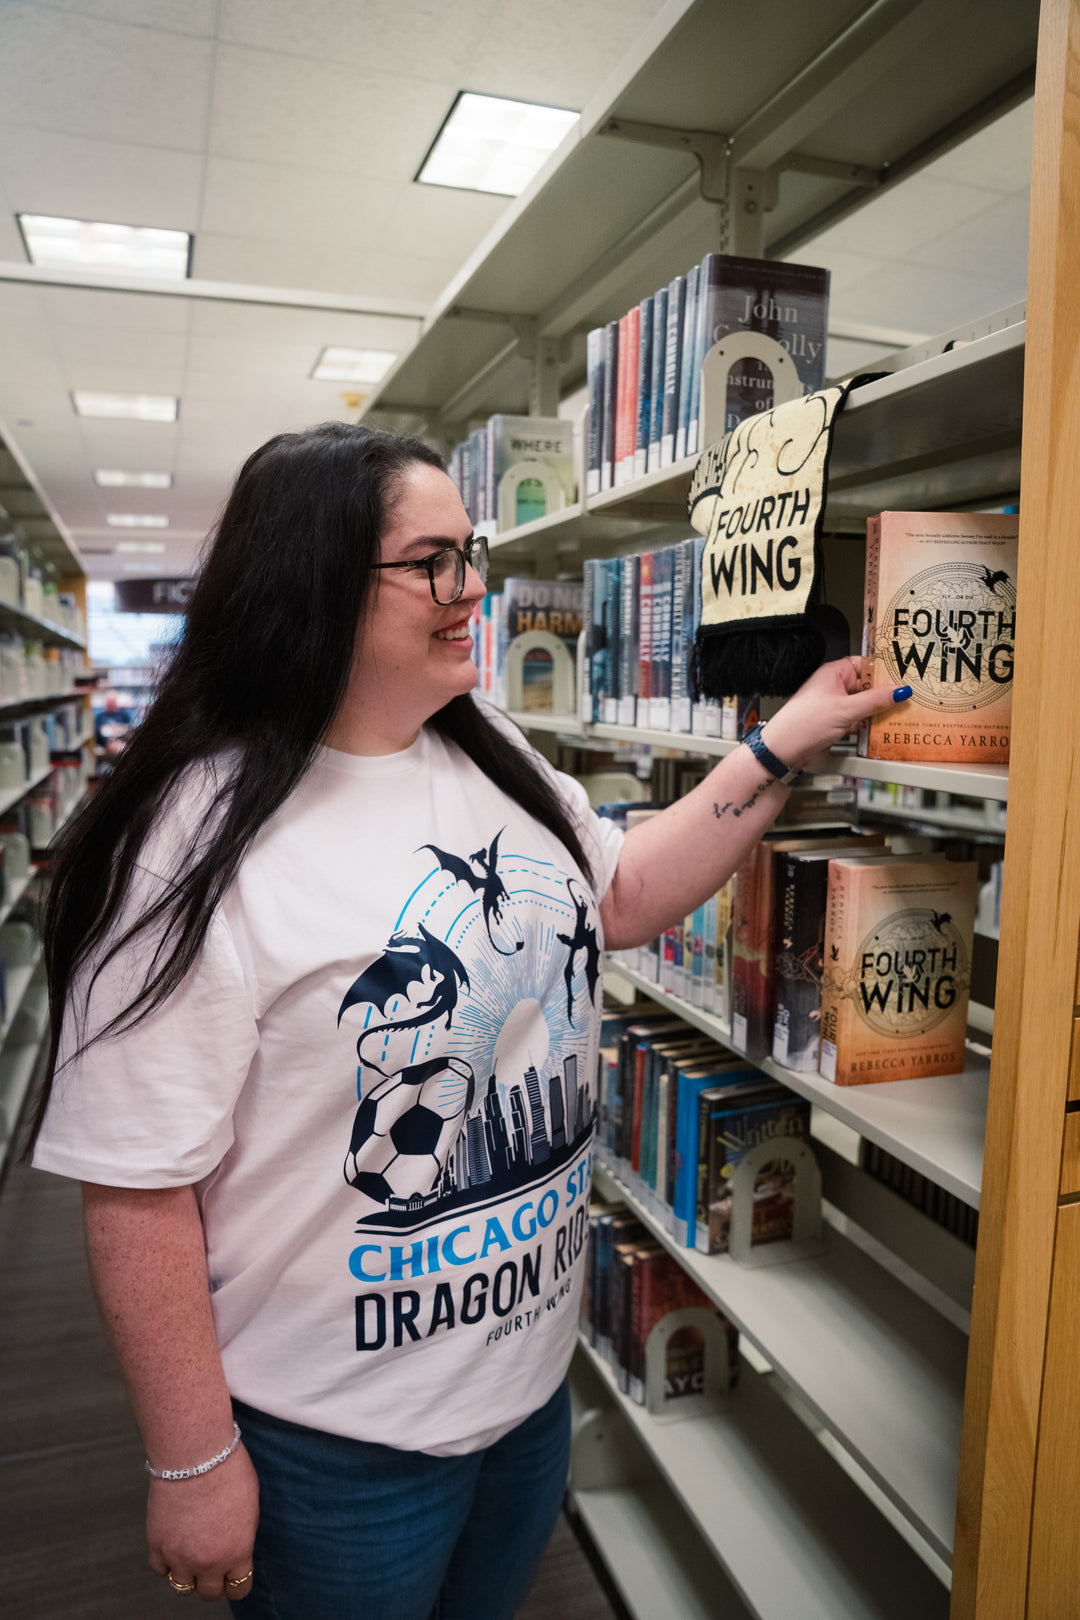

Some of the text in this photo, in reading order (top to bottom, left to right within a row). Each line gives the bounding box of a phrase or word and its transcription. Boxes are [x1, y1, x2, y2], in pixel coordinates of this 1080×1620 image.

[738, 294, 798, 324] John
[713, 324, 823, 364] Colly
[713, 487, 811, 545] FOURTH
[710, 535, 802, 600] WING
[893, 608, 1017, 641] FOURTH
[891, 640, 1015, 685] WING
[883, 732, 1010, 748] REBECCA YARRO
[861, 947, 958, 979] FOURTH
[859, 975, 957, 1015] WING
[821, 1012, 831, 1041] WIN
[828, 1005, 839, 1045] FOUR
[850, 1058, 905, 1073] REBECCA
[349, 1189, 559, 1283] CHICAGO
[355, 1244, 543, 1352] DRAGON
[486, 1306, 542, 1347] FOURTH
